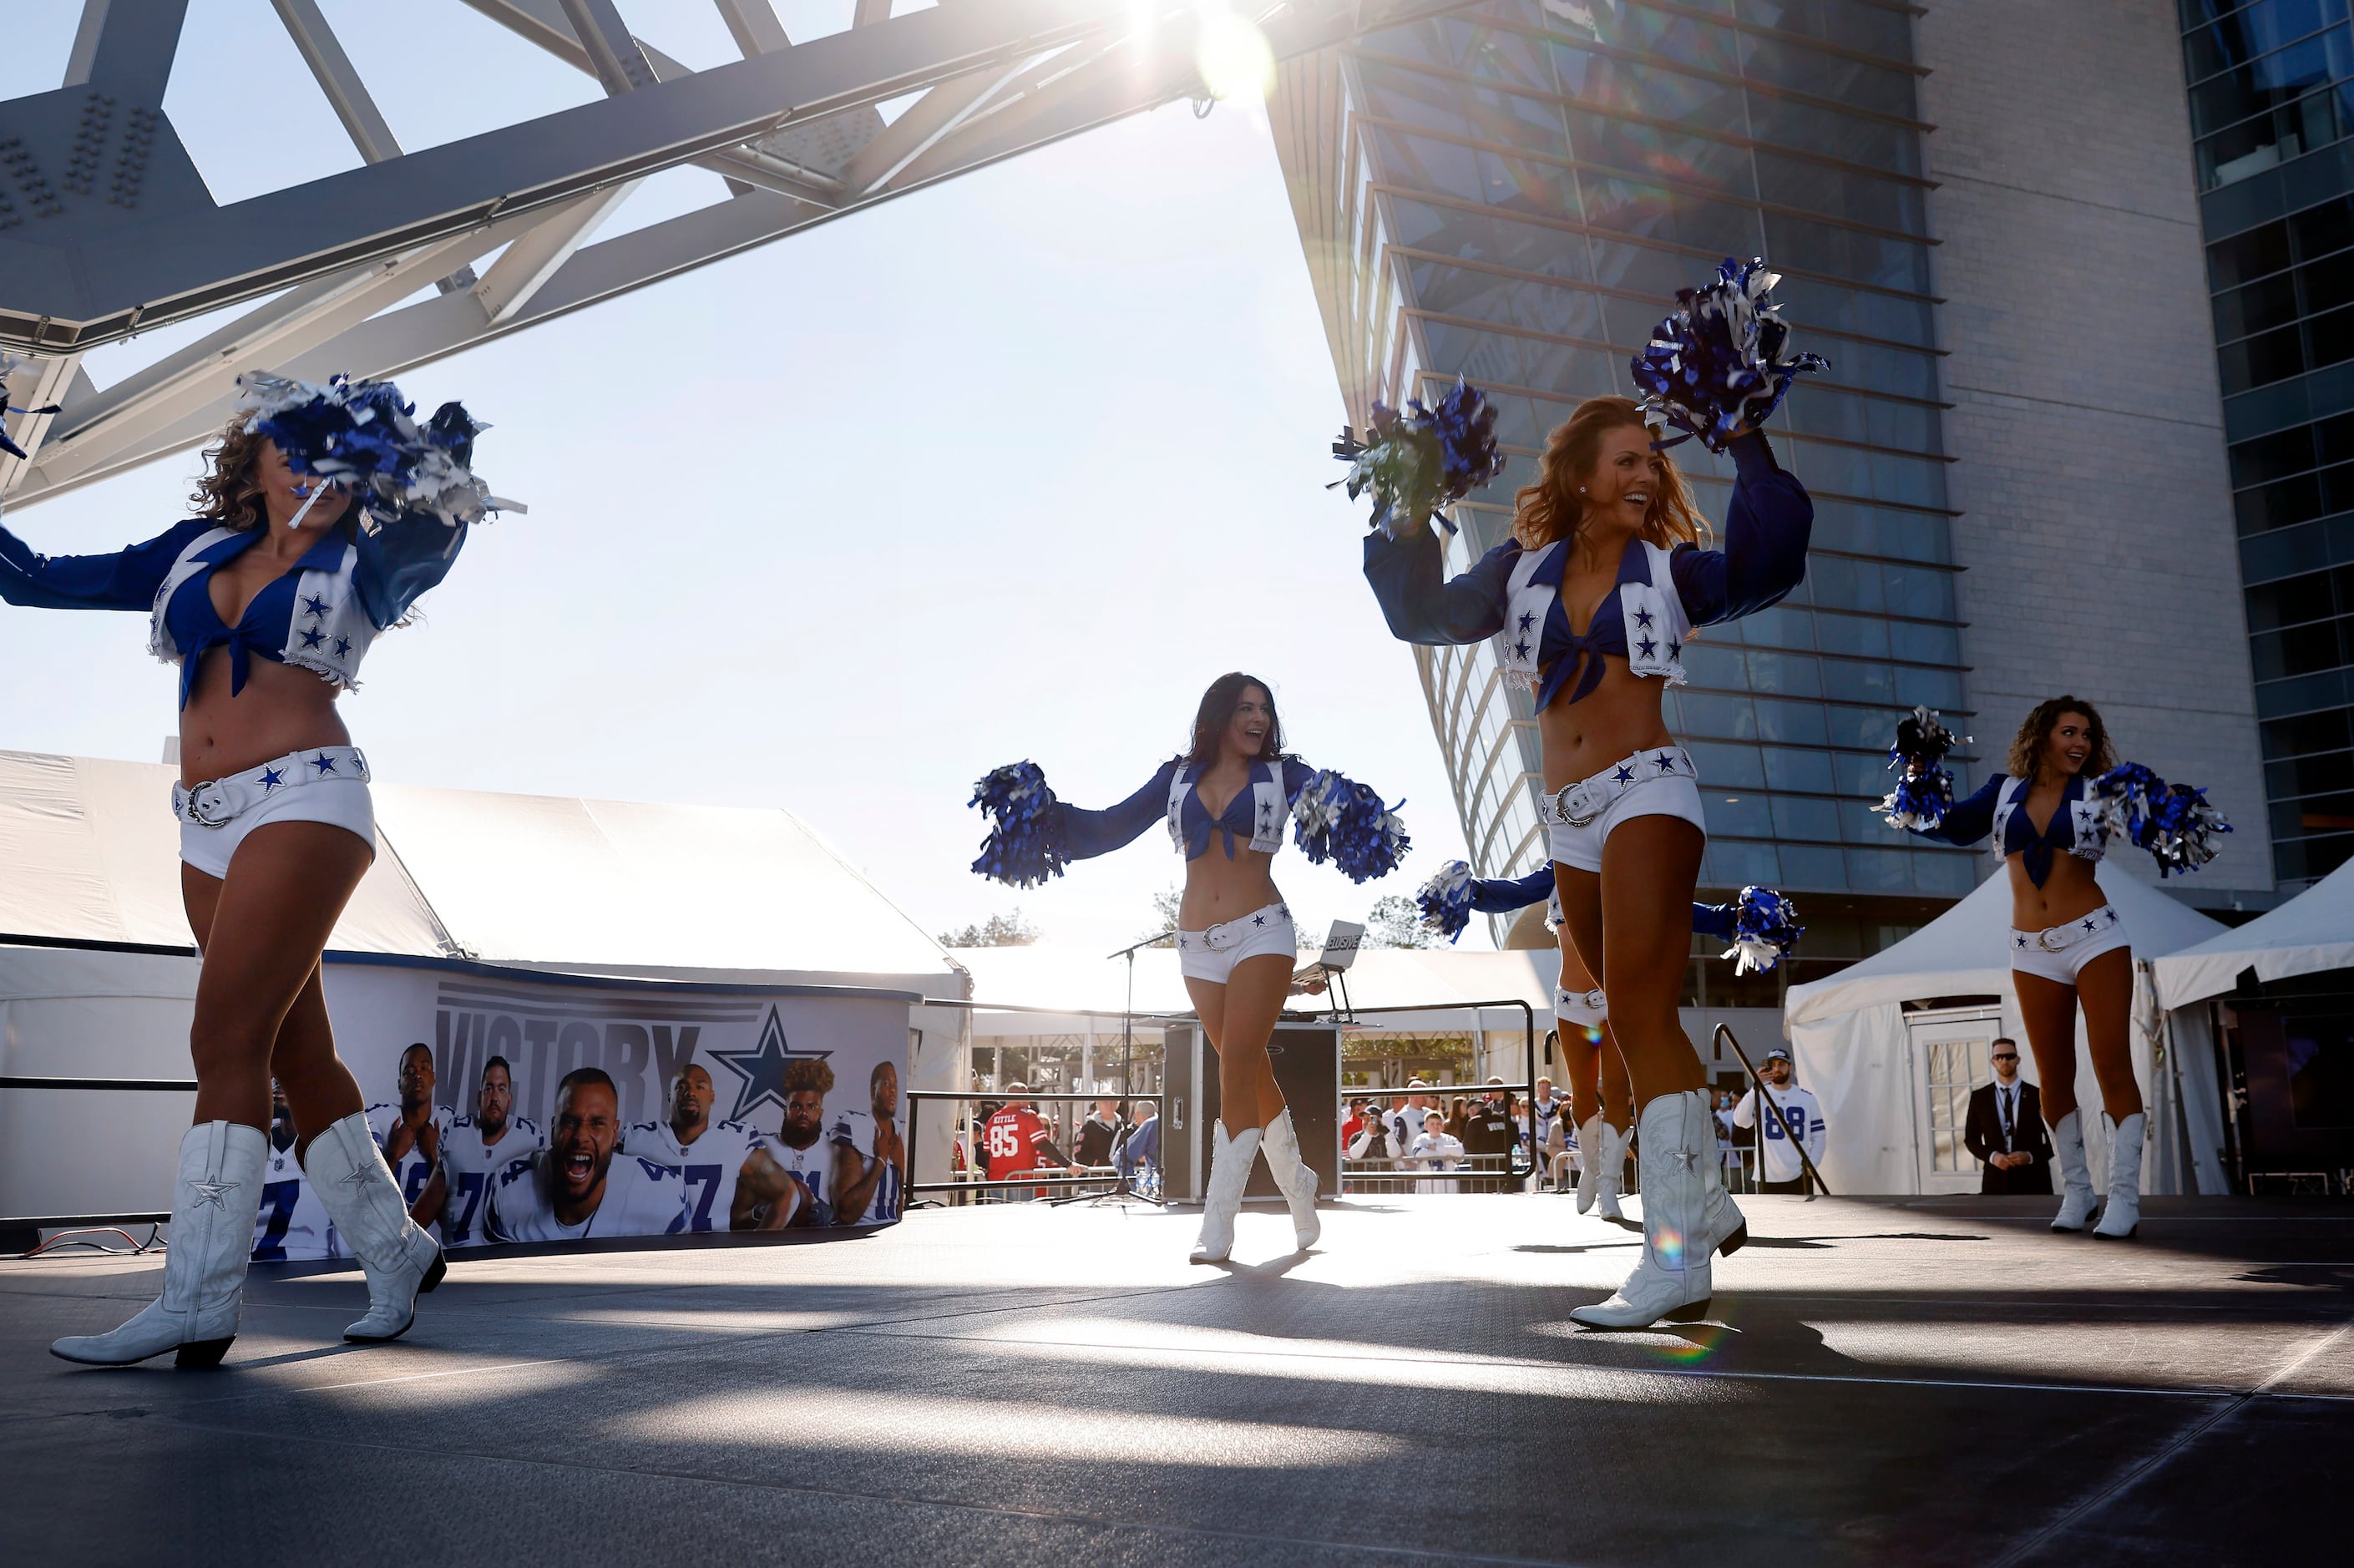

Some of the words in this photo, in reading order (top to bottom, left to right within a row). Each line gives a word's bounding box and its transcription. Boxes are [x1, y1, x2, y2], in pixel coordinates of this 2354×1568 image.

[1326, 935, 1361, 951] ELUSIVE
[434, 1010, 701, 1124] VICTORY
[994, 1115, 1016, 1124] KITTLE
[1765, 1106, 1805, 1141] 88
[990, 1124, 1019, 1158] 85
[501, 1160, 533, 1187] 4
[453, 1173, 495, 1242] 7
[875, 1165, 899, 1220] 11
